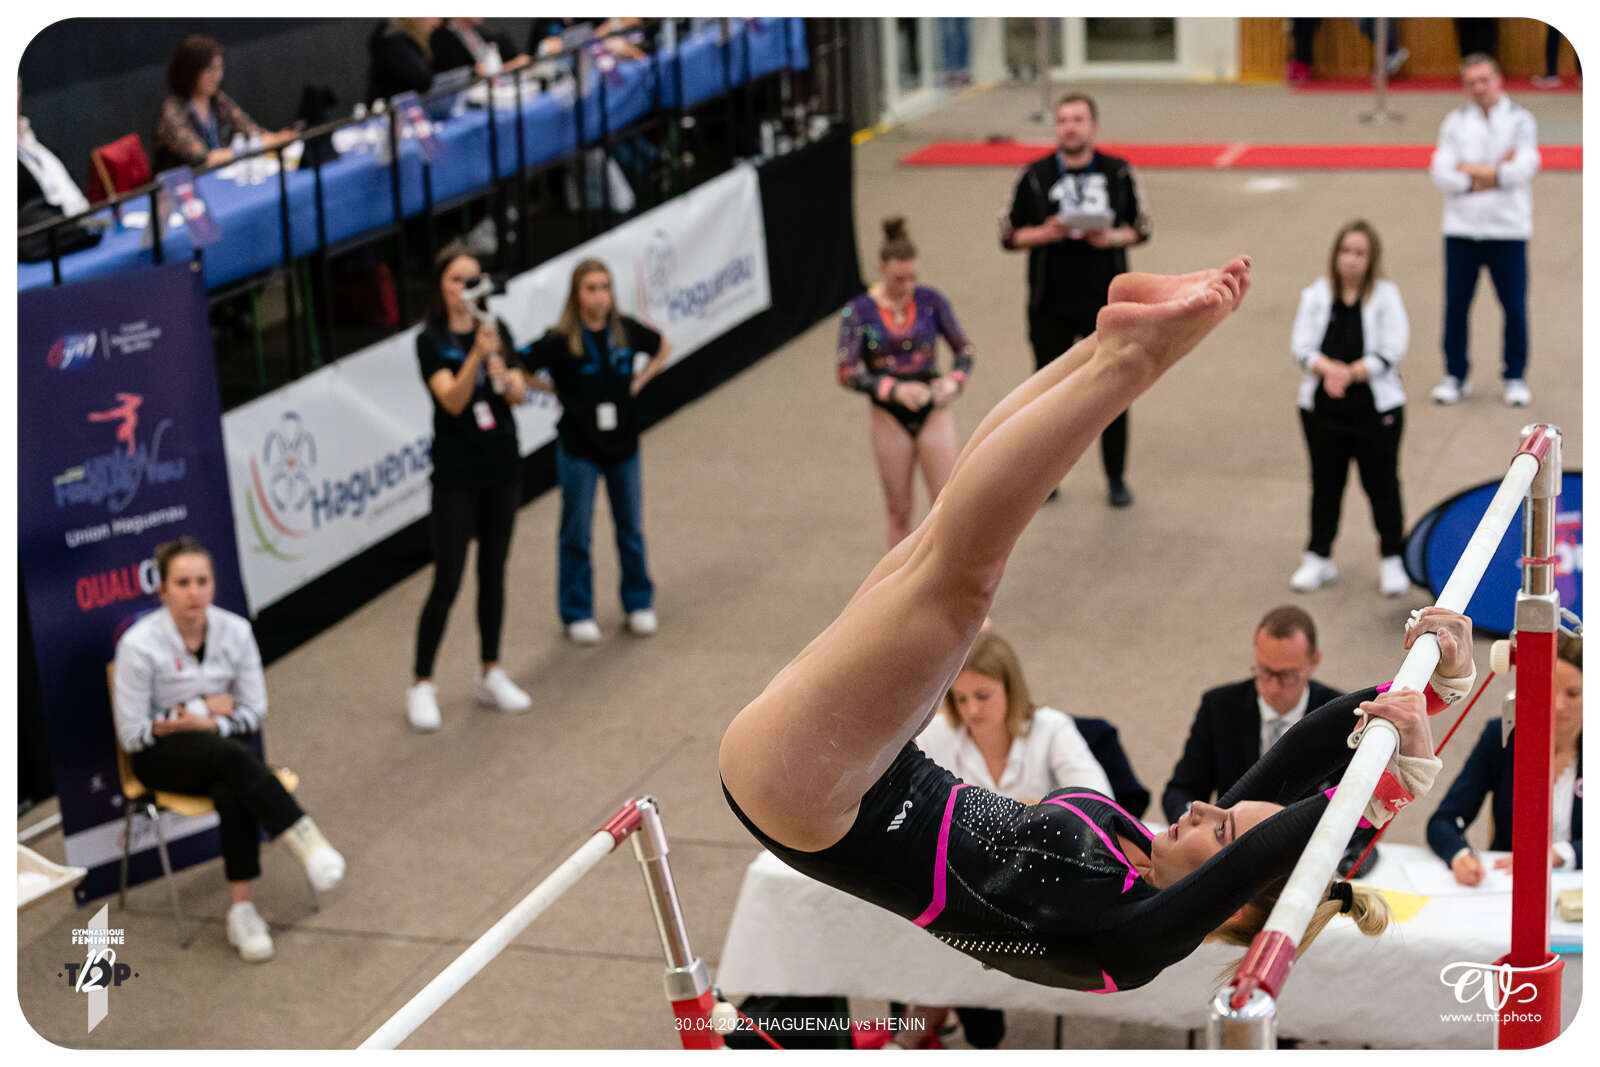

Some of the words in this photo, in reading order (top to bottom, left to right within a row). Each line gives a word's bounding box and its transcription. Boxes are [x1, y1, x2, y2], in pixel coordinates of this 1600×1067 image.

[307, 436, 433, 529] Haguena
[65, 522, 111, 548] Union
[111, 504, 187, 535] Haguenau
[75, 556, 162, 612] QUALIC
